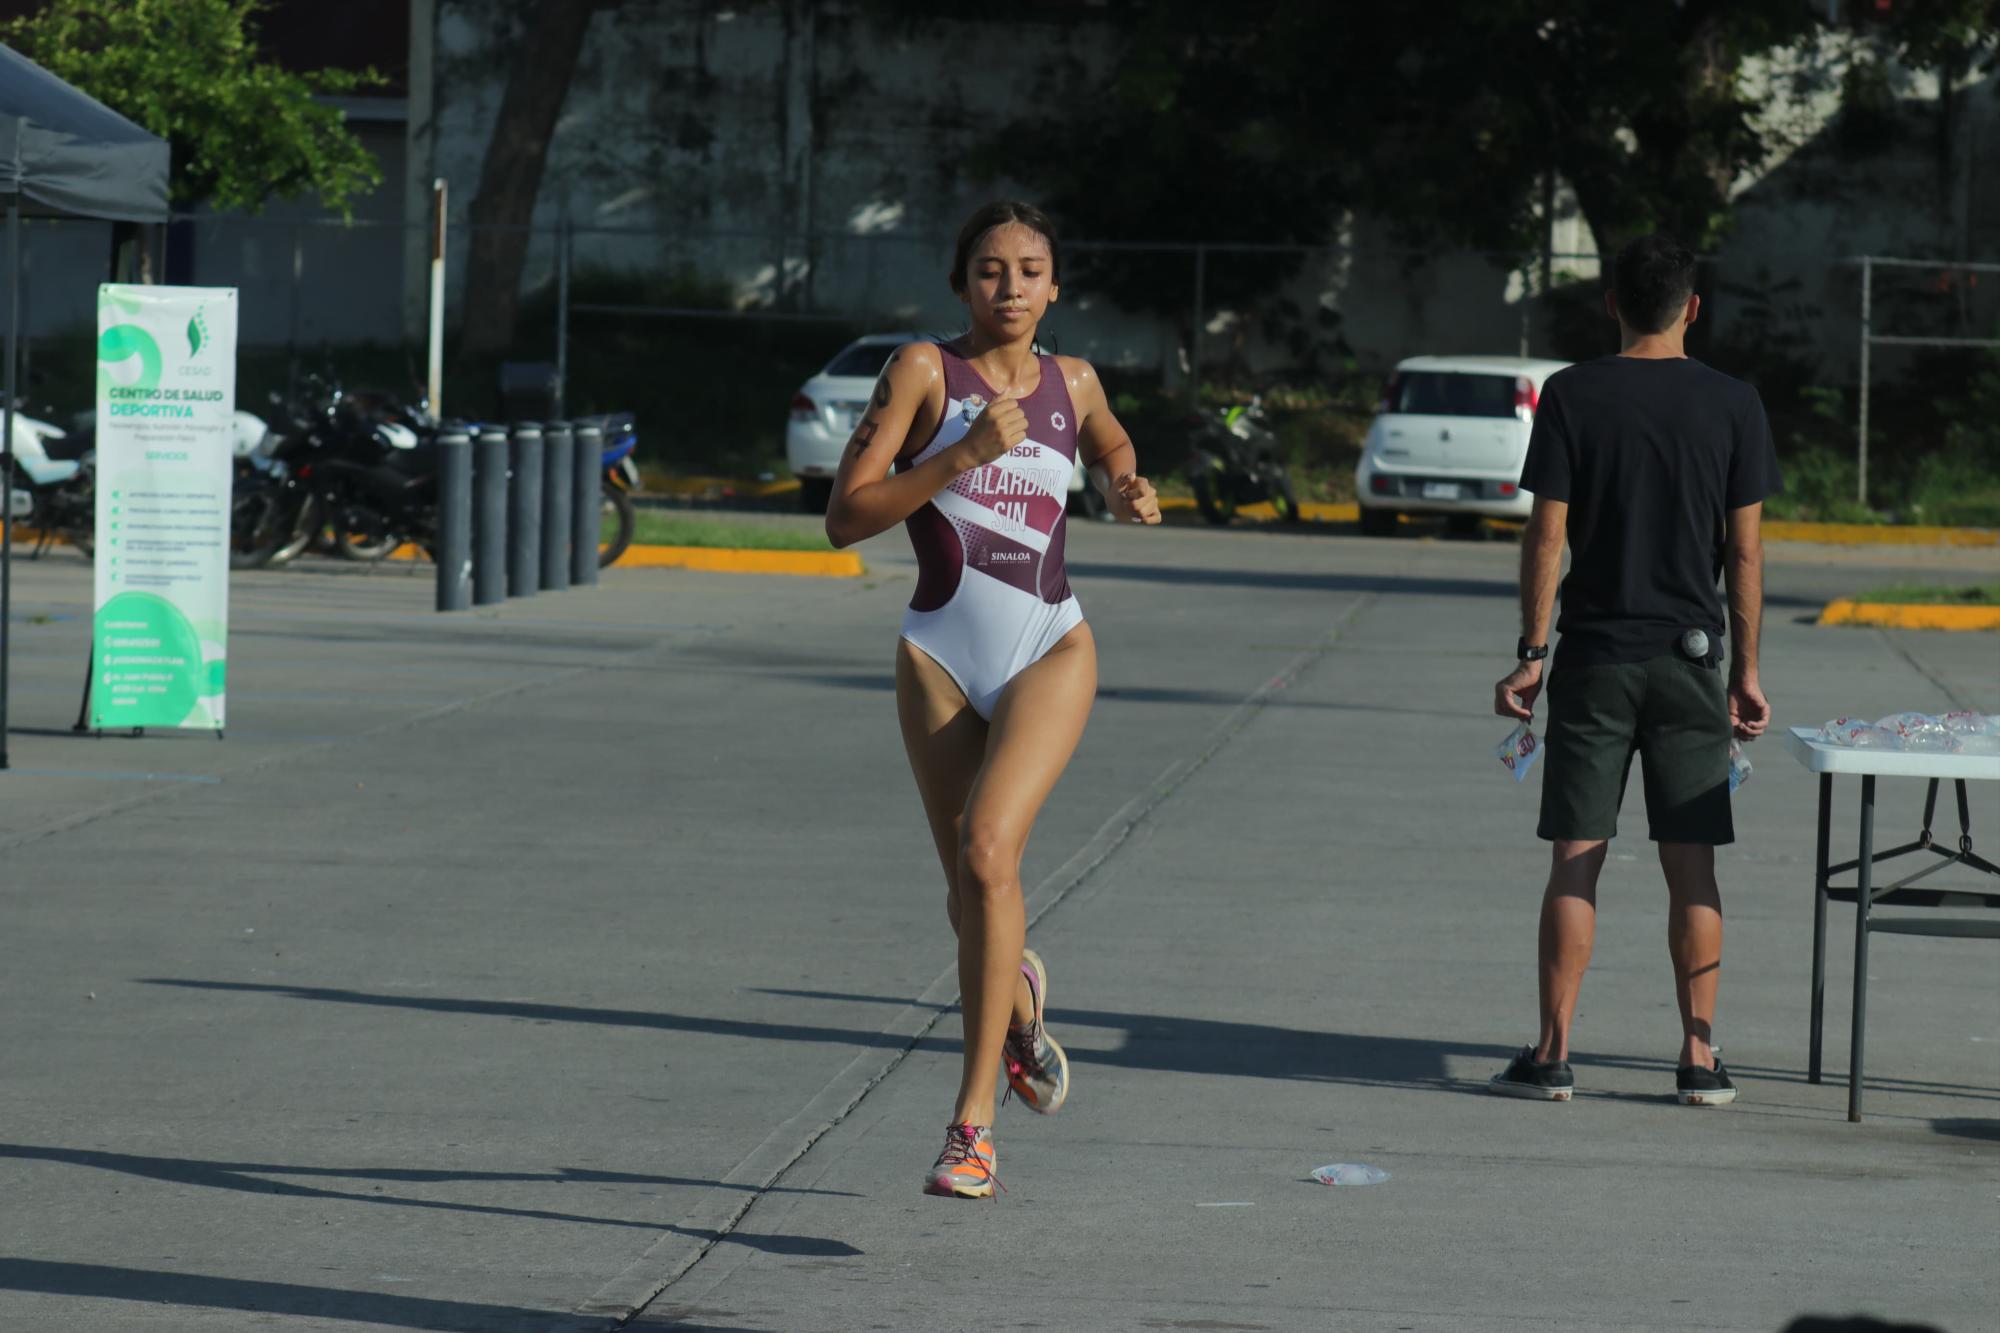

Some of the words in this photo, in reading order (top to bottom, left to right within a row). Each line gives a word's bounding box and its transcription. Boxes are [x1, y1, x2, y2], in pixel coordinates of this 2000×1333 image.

[109, 387, 162, 400] CENTRO
[164, 389, 180, 400] DE
[183, 390, 223, 401] SALUD
[109, 403, 193, 418] DEPORTIVA
[992, 501, 1028, 532] SIN
[990, 552, 1031, 561] SINALOA
